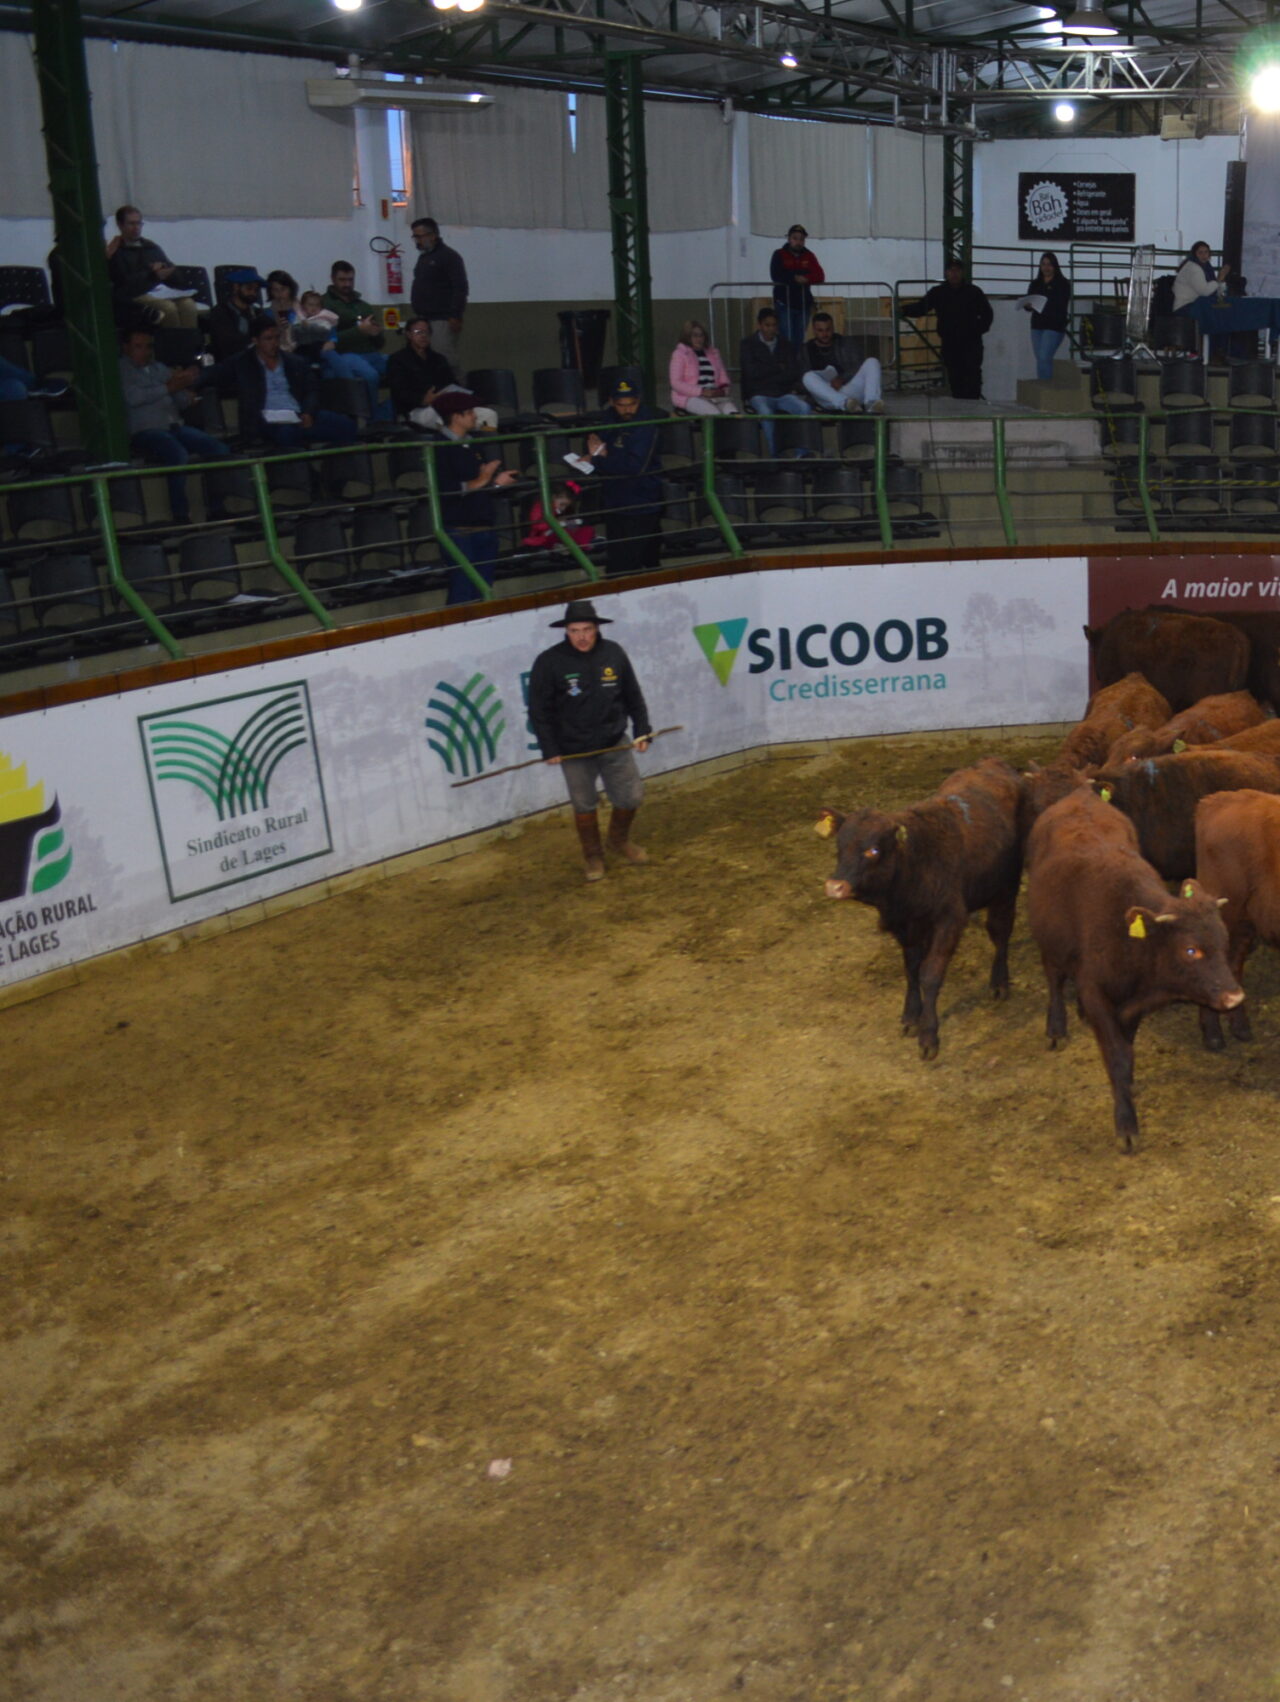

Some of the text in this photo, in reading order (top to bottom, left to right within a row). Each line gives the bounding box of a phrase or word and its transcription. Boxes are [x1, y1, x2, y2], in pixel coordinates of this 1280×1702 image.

[1032, 195, 1063, 216] Bah
[1160, 578, 1178, 599] A
[1183, 577, 1254, 599] maior
[747, 616, 949, 674] SICOOB
[769, 671, 947, 702] Credisserrana
[186, 807, 309, 857] Sindicato Rural
[219, 842, 287, 873] de Lages
[41, 893, 98, 926] RURAL
[8, 930, 60, 963] LAGES
